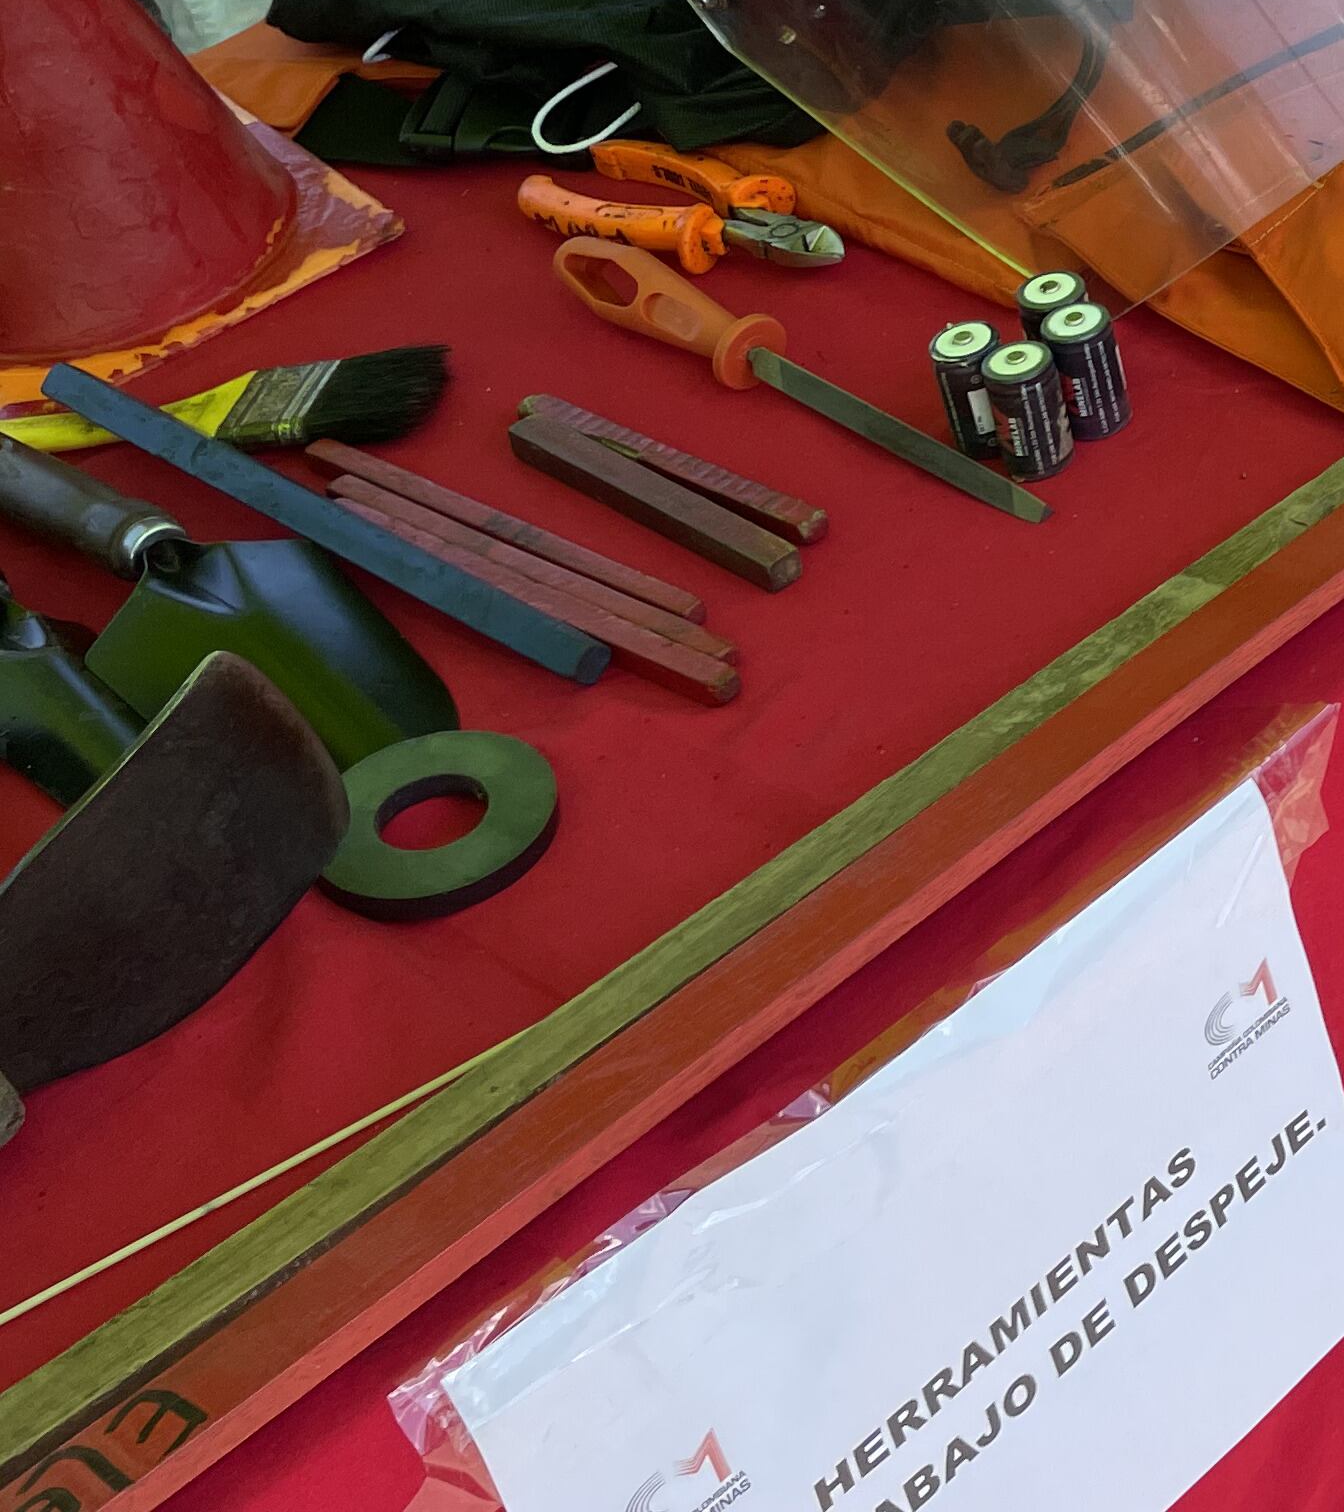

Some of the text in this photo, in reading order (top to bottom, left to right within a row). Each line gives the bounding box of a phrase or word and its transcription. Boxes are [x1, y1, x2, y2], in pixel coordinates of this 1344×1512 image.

[1210, 1002, 1291, 1080] CONTRA MINAS
[813, 1147, 1196, 1512] HERRAMIENTAS
[1048, 1298, 1116, 1378] DE
[1122, 1108, 1327, 1308] DESPEJE.
